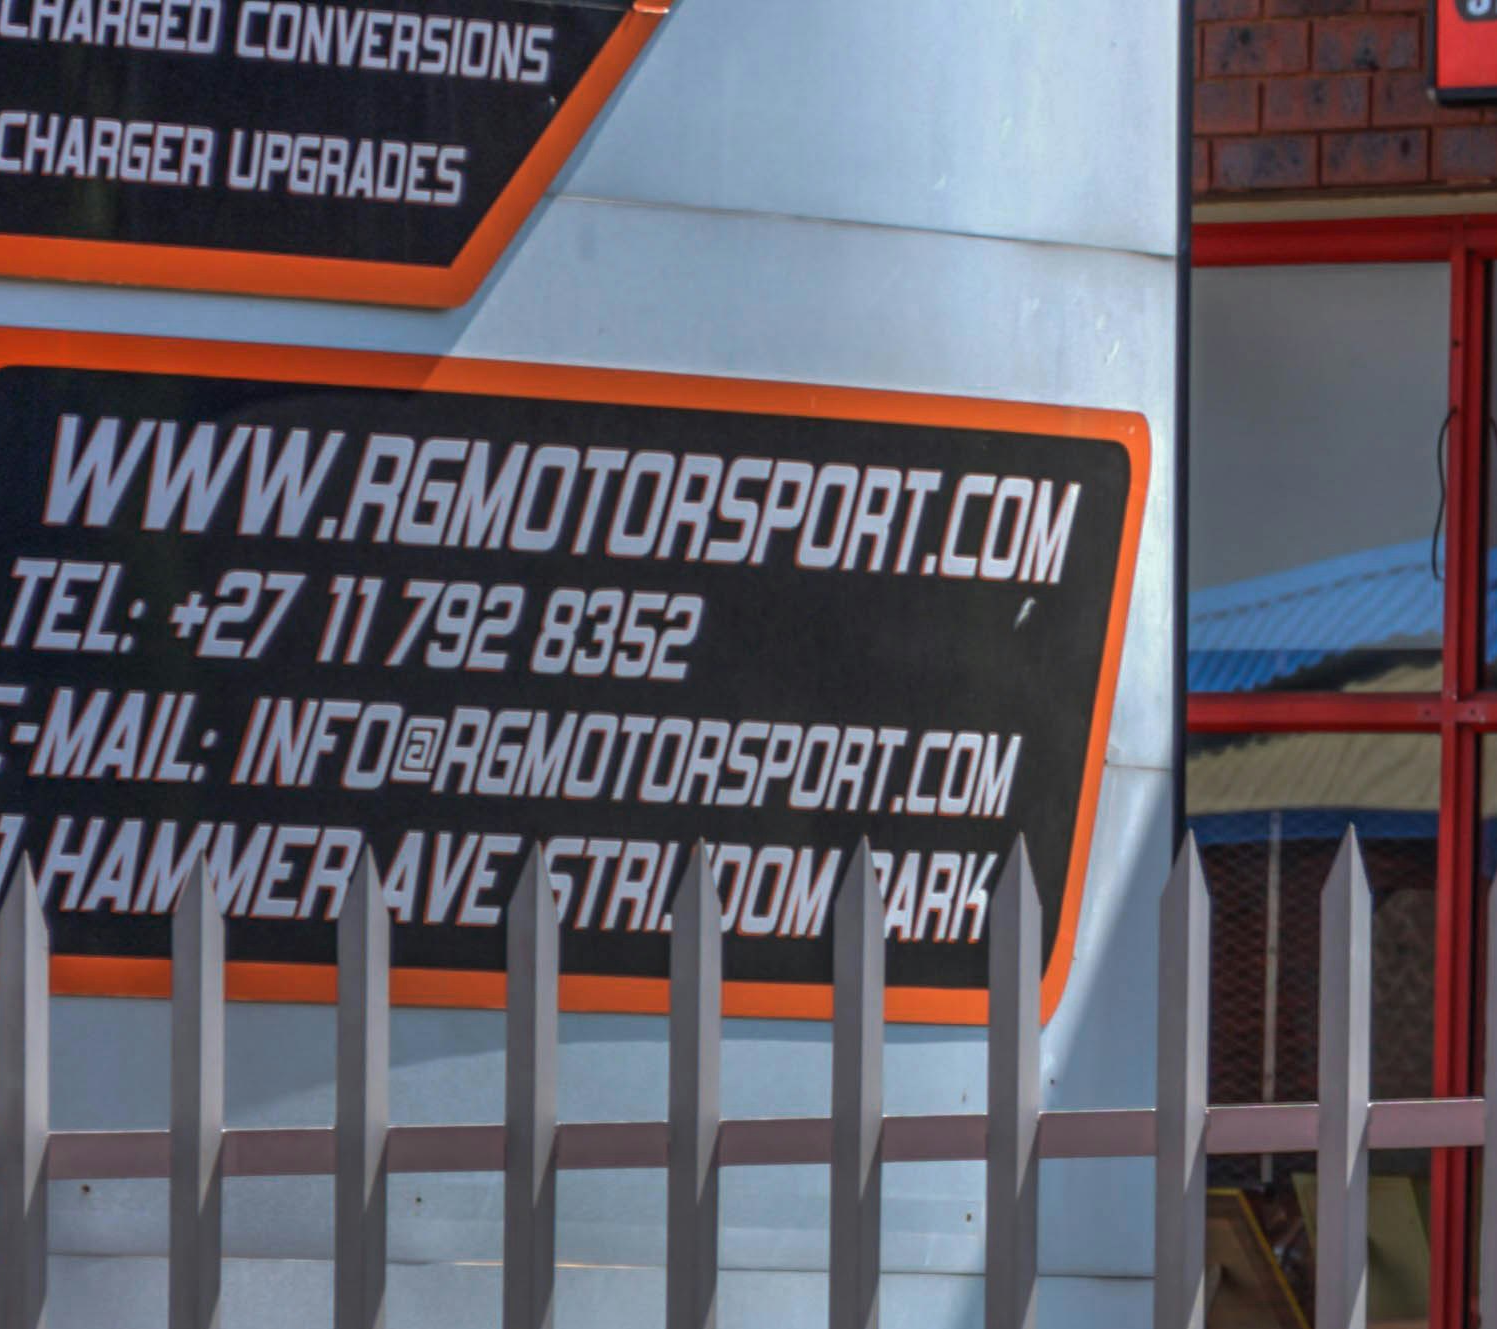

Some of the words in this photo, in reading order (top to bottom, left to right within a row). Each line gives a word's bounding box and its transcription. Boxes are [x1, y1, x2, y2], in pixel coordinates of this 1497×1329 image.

[235, 0, 553, 83] CONVERSIONS
[229, 129, 466, 205] UPGRADES
[43, 413, 1081, 584] WWW.RGMOTORSPORT.COM
[0, 557, 146, 653] TEL:
[169, 570, 306, 659] +27
[316, 575, 384, 664] 11
[385, 578, 524, 672] 792
[530, 587, 704, 681] 8352
[231, 698, 1022, 817] INFO@RGMOTORSPORT.COM
[37, 815, 363, 919] HAMMER
[383, 830, 522, 926] AVE
[542, 837, 841, 938] STRIDOM
